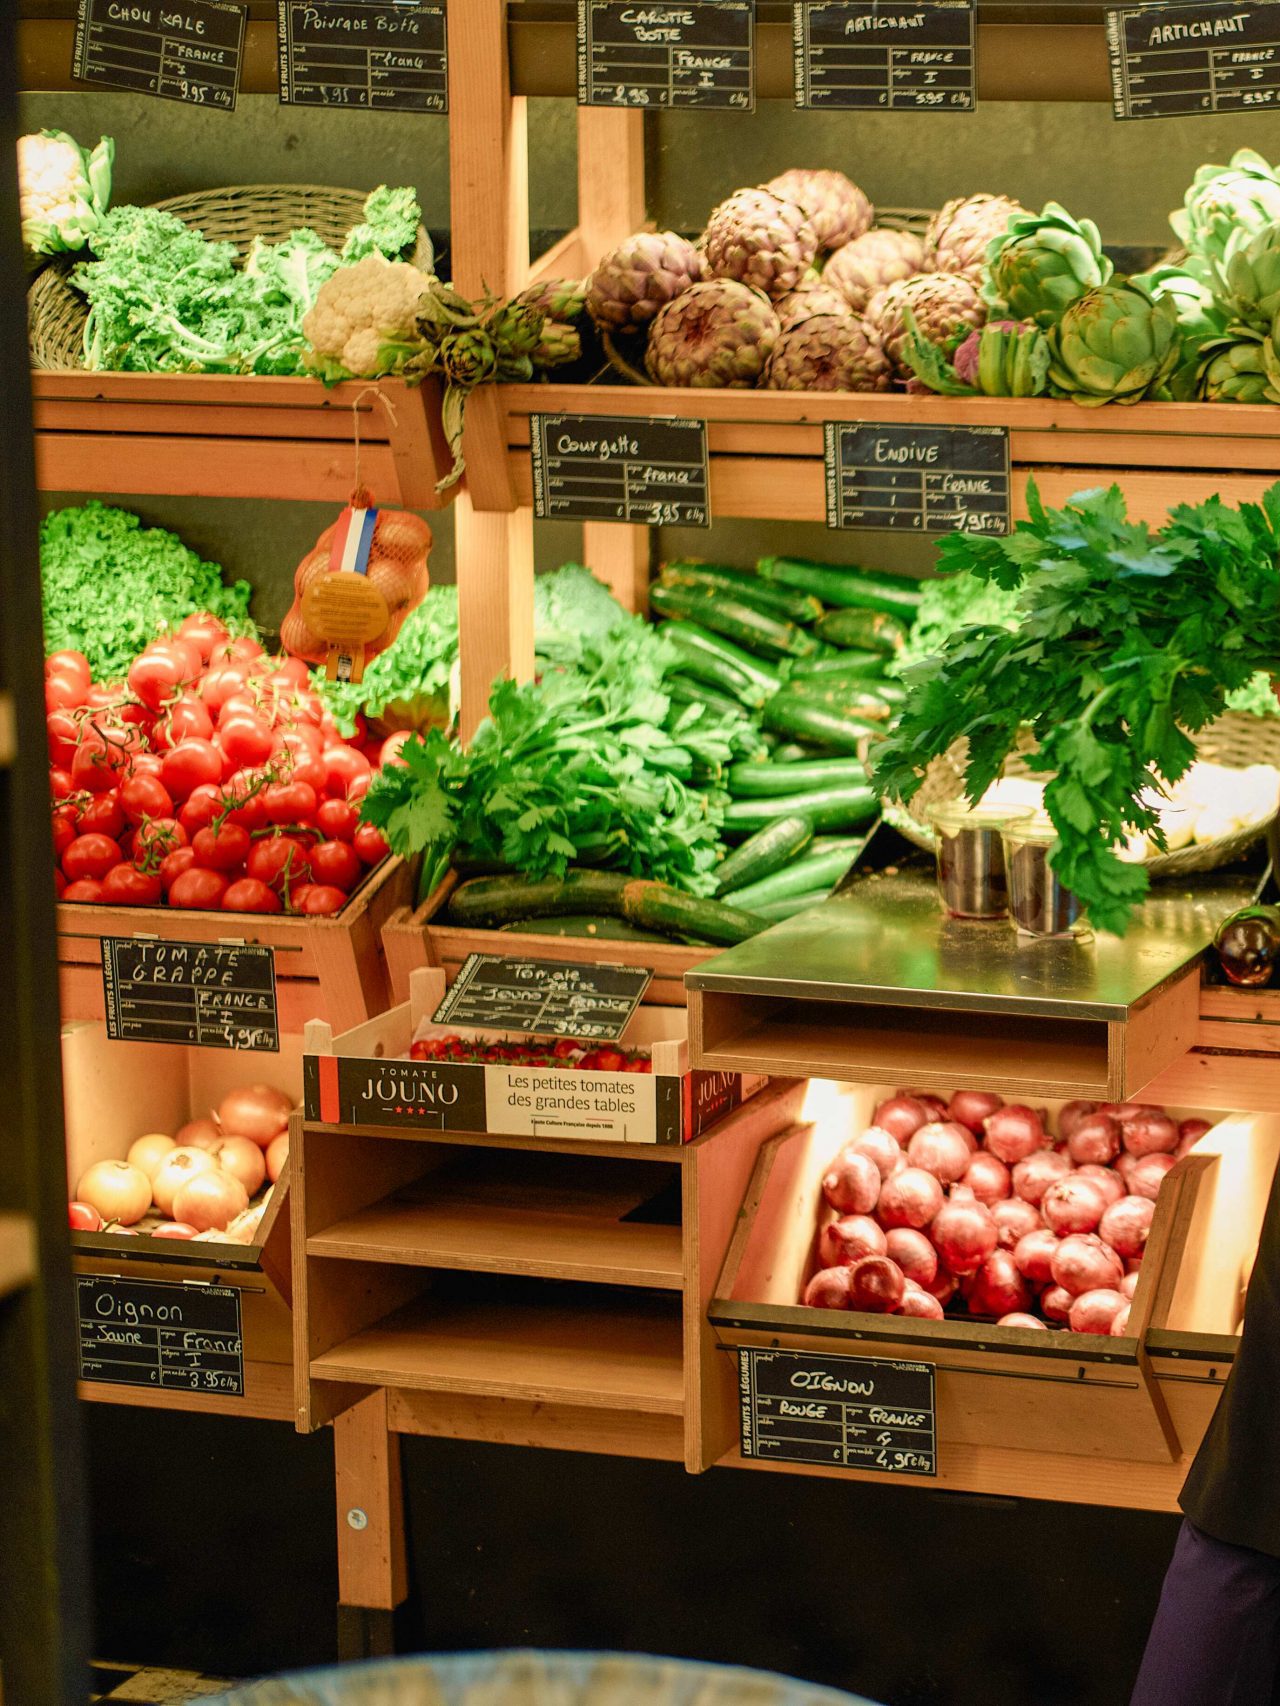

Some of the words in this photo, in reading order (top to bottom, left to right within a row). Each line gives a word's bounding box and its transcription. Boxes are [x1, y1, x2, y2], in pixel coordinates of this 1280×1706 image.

[108, 3, 151, 24] CHOU
[620, 8, 696, 26] CAROTTE
[634, 25, 682, 42] BOTTE
[844, 13, 926, 36] ARTICHAUT
[1148, 14, 1251, 46] ARTICHAUT
[178, 46, 224, 62] FRANCE
[672, 50, 732, 68] FRANCE
[910, 52, 954, 64] FRANCE
[1231, 49, 1275, 62] FRANCE
[180, 80, 208, 102] 9.95
[557, 434, 640, 460] Courgette
[138, 945, 239, 966] TOMATE
[132, 964, 234, 986] GRAPPE
[198, 990, 268, 1009] FRANCE
[220, 1011, 234, 1024] I
[380, 1067, 438, 1079] TOMATE
[361, 1079, 460, 1106] JOUNO
[508, 1074, 529, 1088] Les
[532, 1076, 577, 1092] petites
[580, 1078, 635, 1095] tomates
[508, 1092, 532, 1107] des
[536, 1096, 590, 1111] grandes
[594, 1098, 636, 1113] tables
[95, 1293, 182, 1326] Oignon
[183, 1331, 242, 1353] France
[184, 1352, 202, 1368] I
[740, 1350, 750, 1395] LÉGUMES
[790, 1370, 874, 1396] OIGNON
[780, 1400, 829, 1418] ROUGE
[868, 1407, 926, 1427] FRANCE
[742, 1404, 752, 1438] FRUITS
[744, 1438, 752, 1455] LES
